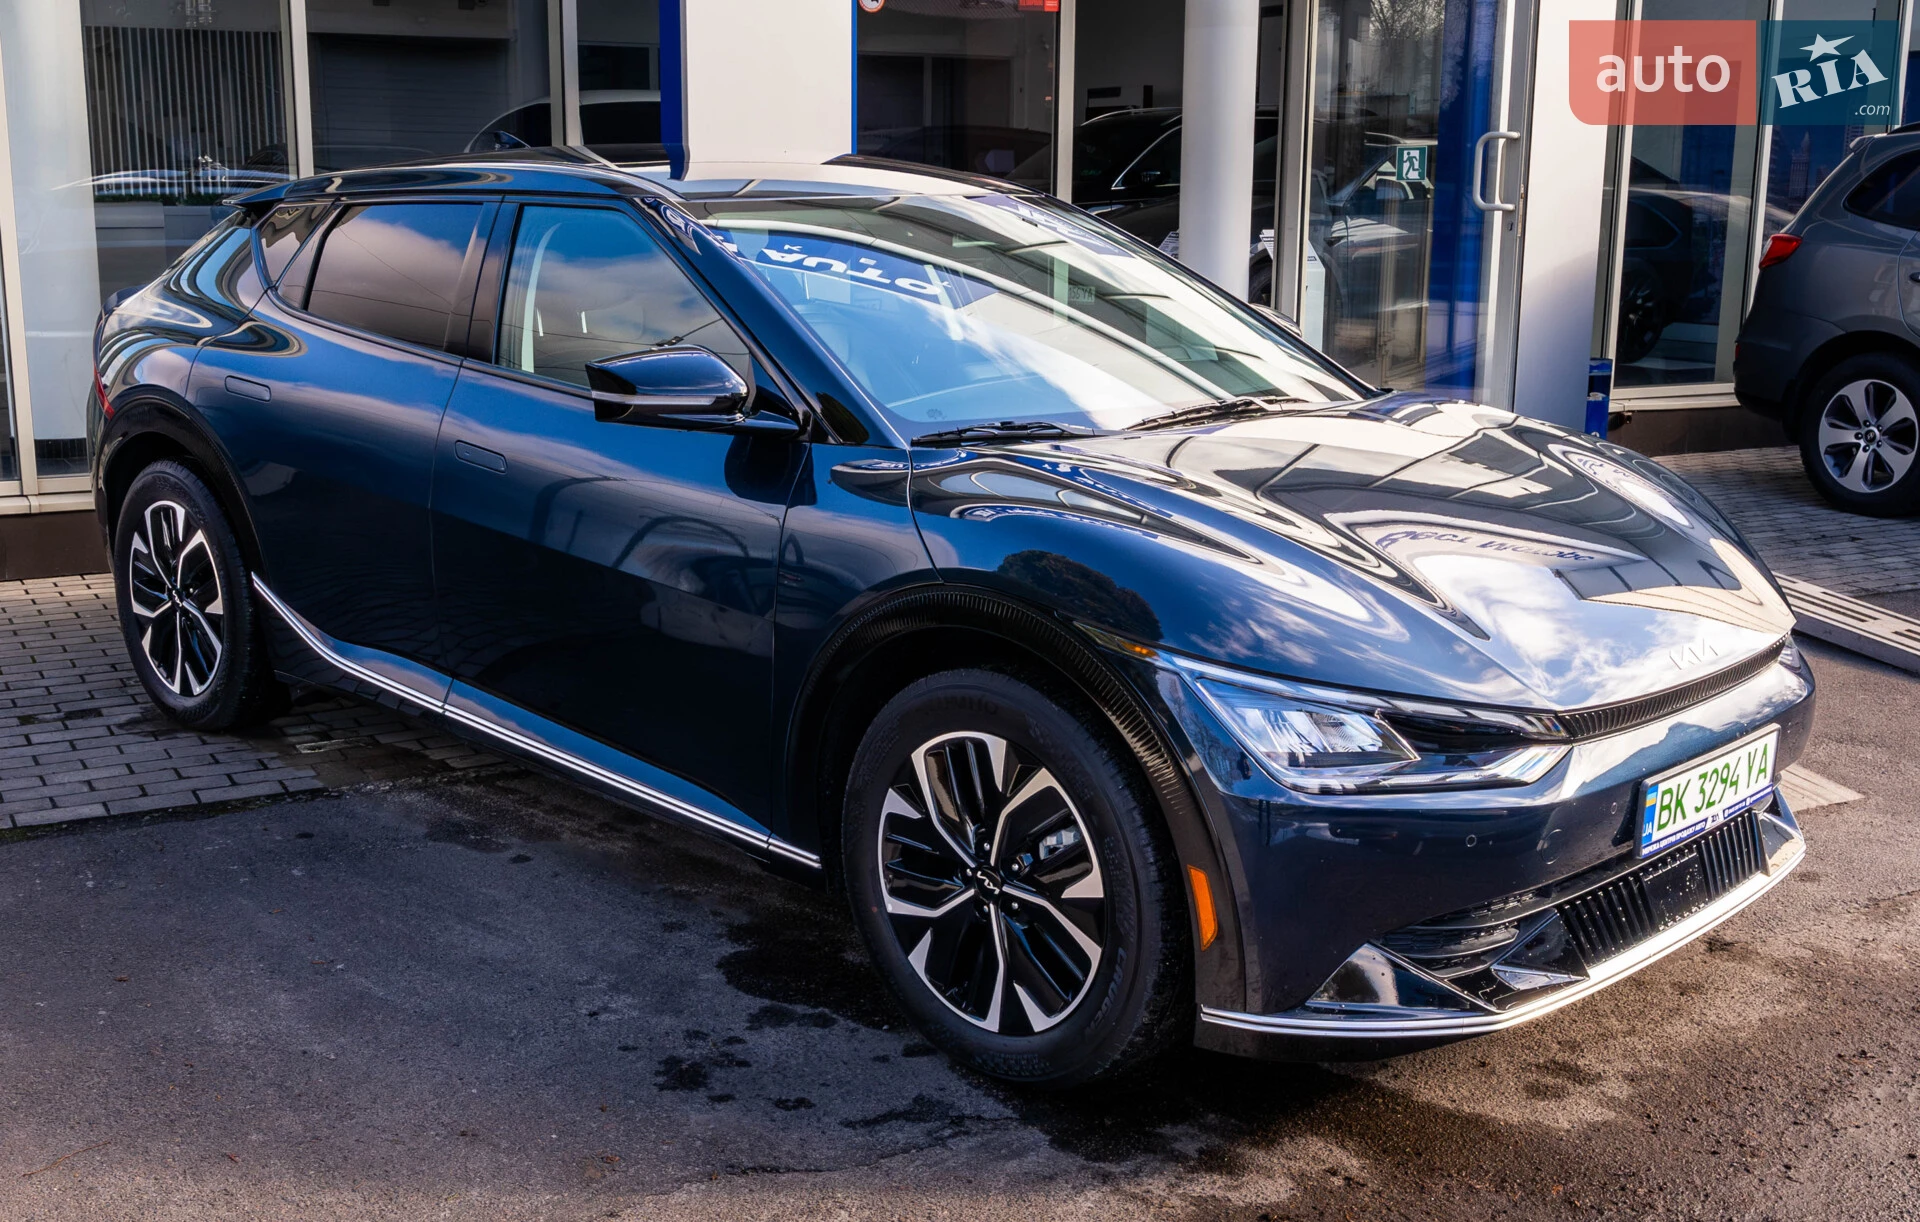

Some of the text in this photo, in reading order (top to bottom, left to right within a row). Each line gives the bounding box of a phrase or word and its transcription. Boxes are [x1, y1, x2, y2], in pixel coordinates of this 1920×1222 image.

[1669, 638, 1718, 671] KIA
[1656, 743, 1769, 832] BK 3294 YA
